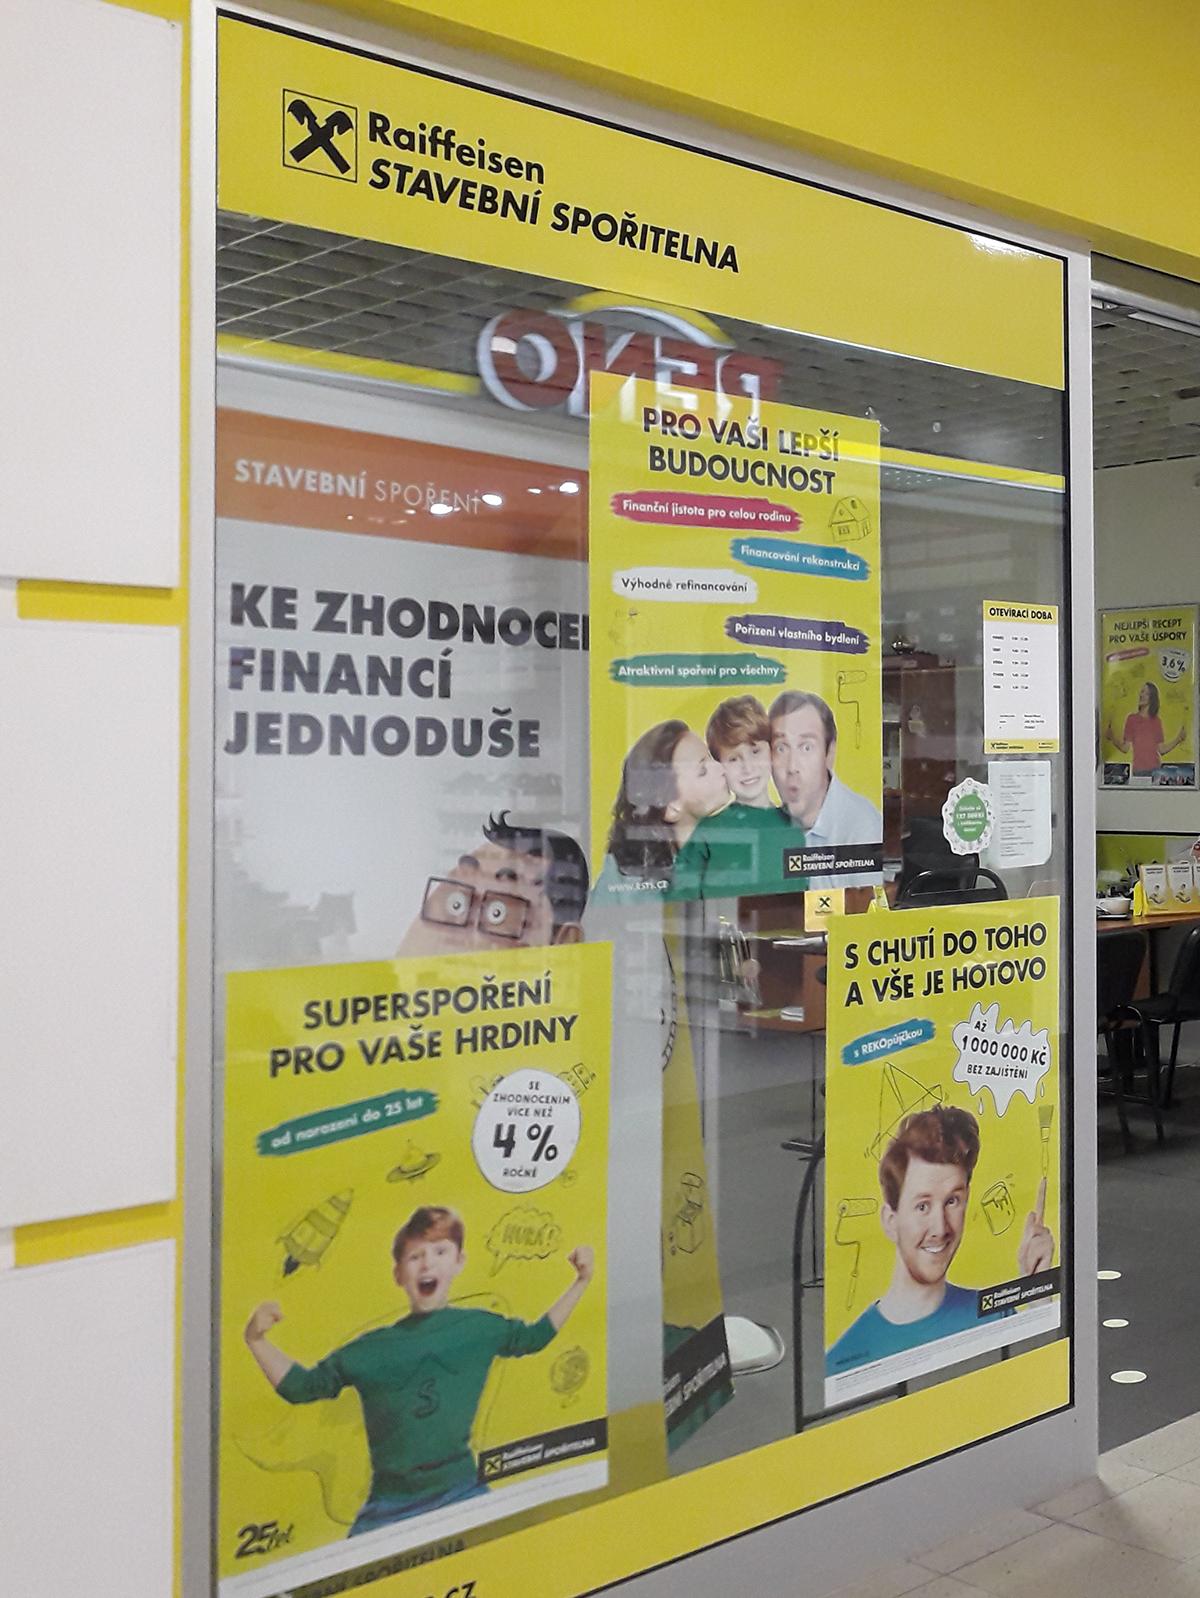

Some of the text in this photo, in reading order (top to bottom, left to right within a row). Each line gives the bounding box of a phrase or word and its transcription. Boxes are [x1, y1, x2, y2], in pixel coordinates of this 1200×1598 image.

[368, 111, 545, 184] Raiffeisen
[369, 157, 739, 273] STAVEBNÍ SPOŘITELNA
[643, 407, 839, 462] PRO VAŠI LEPŠÍ
[234, 459, 367, 499] STAVEBNÍ
[649, 446, 836, 495] BUDOUCNOST
[623, 499, 791, 523] Finanční jistota pro celou rodinu
[741, 544, 800, 563] Financování
[621, 576, 748, 593] Výhodné refinancování
[230, 582, 299, 630] KE
[989, 608, 1052, 620] OTEVÍRACÍ DOBA
[1114, 618, 1182, 631] NEJLEPŠÍ RECEPT
[735, 622, 860, 647] Pořízení vlastního bydlení
[1109, 631, 1187, 643] PRO VAŠE ÚSPORY
[228, 646, 453, 698] FINANCÍ
[618, 664, 780, 680] Atraktivní spoření pro všechny
[223, 706, 541, 758] JEDNODUŠE
[844, 922, 1047, 969] S CHUTÍ DO TOHO
[303, 969, 553, 1031] SUPERSPOŘENÍ
[845, 957, 1046, 1007] A VŠE JE HOTOVO
[974, 1019, 987, 1033] AŽ
[270, 1014, 579, 1079] PRO VAŠE HRDINY
[1031, 1046, 1047, 1065] KČ
[529, 1080, 541, 1091] SE
[967, 1064, 983, 1075] BEZ
[271, 1096, 425, 1149] od narození do 25 let
[533, 1106, 553, 1118] NEŽ
[493, 1123, 559, 1162] 4 %
